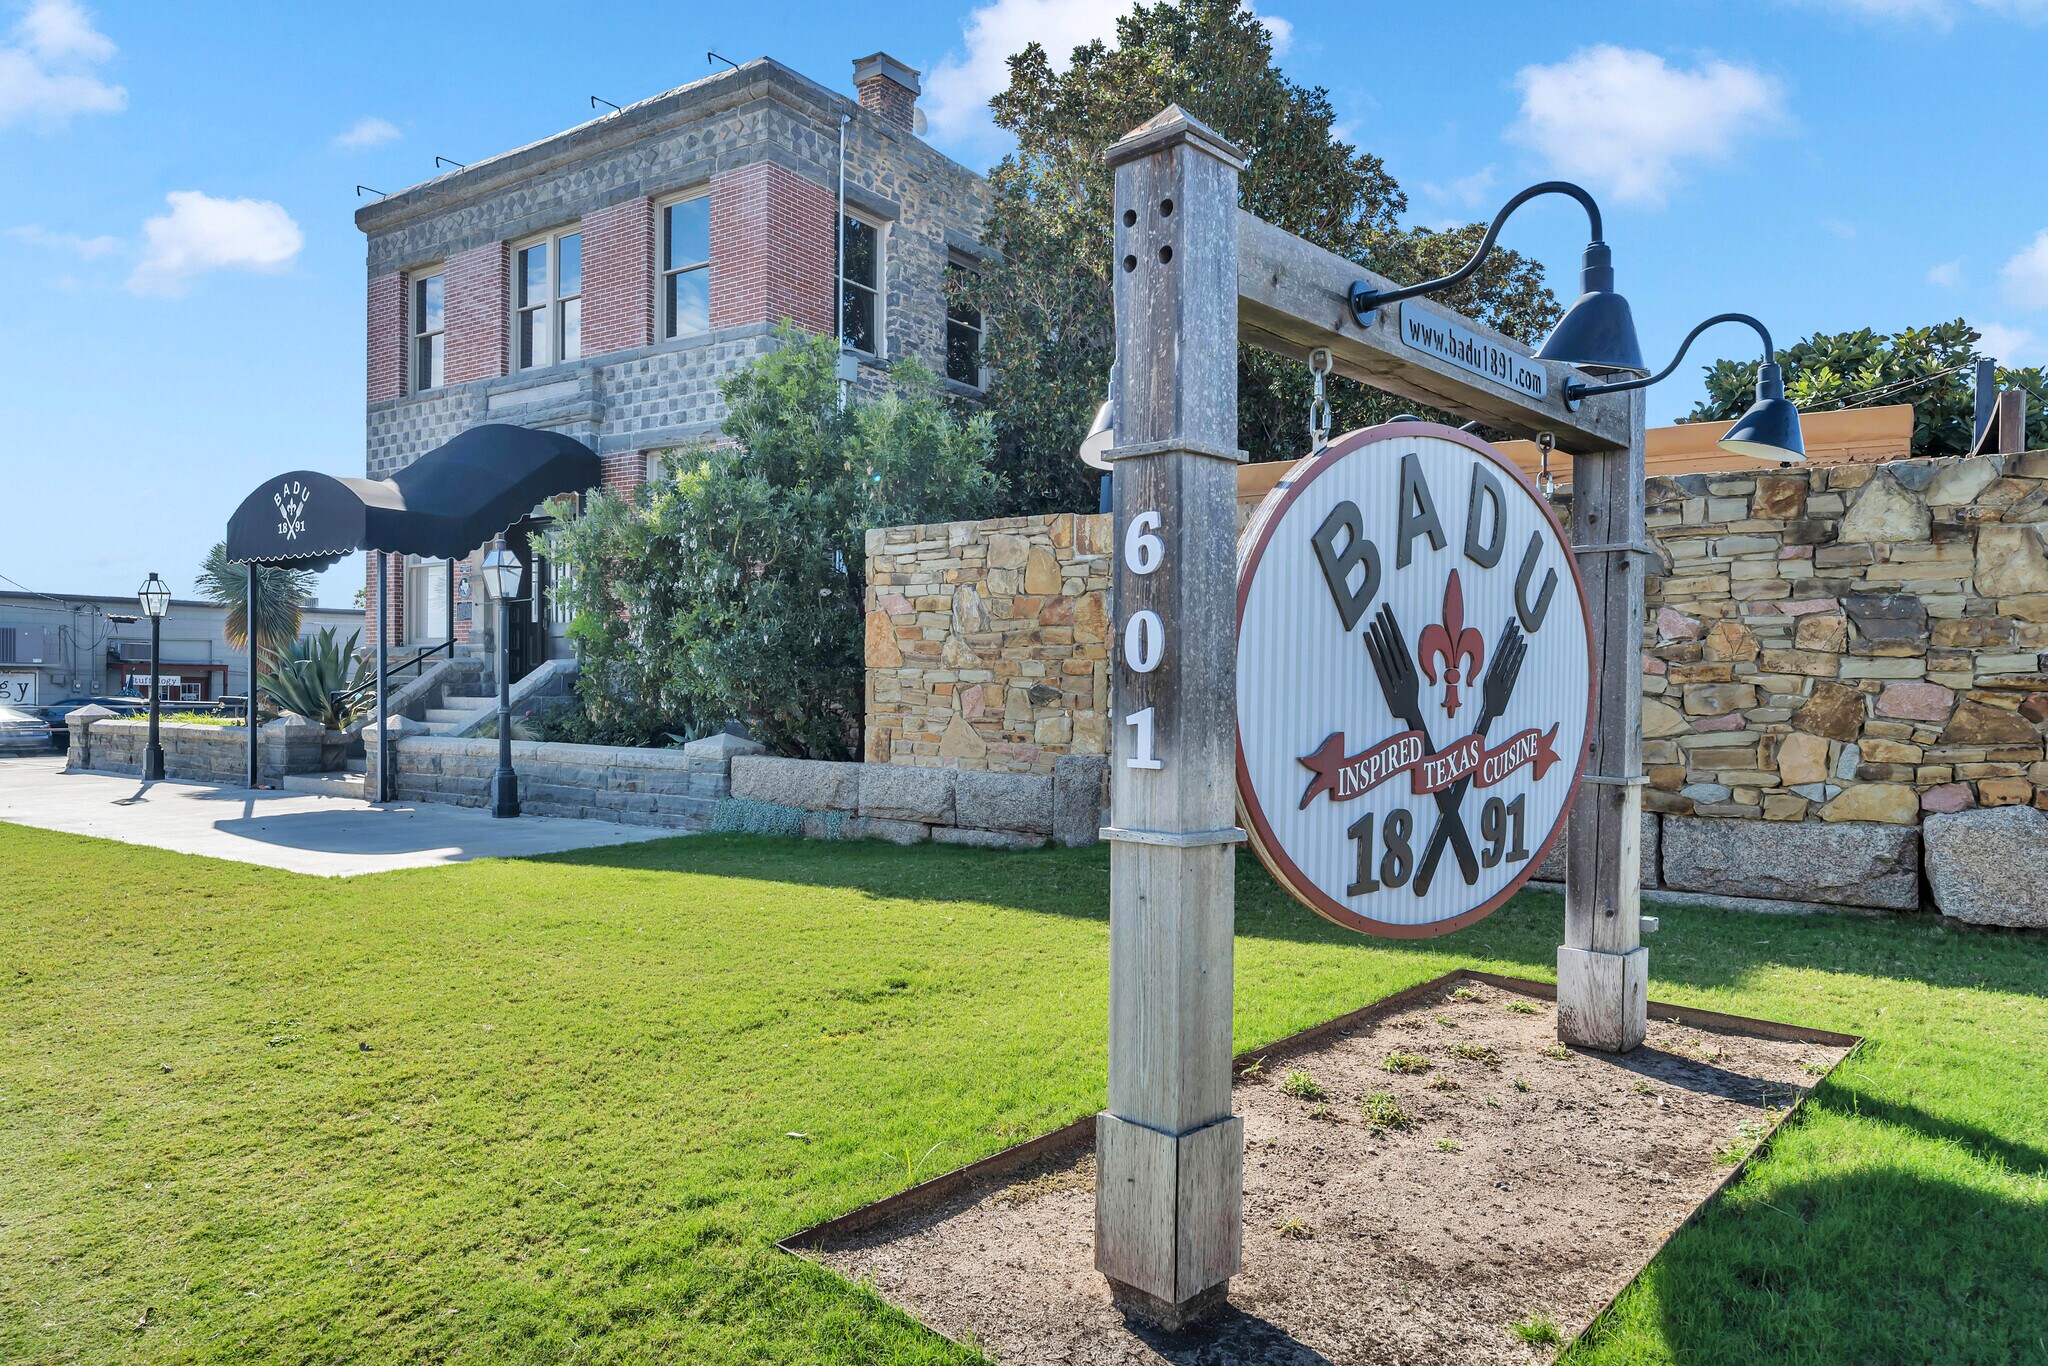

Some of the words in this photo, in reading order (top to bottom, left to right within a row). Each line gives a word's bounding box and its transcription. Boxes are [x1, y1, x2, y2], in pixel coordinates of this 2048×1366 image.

[1408, 318, 1542, 395] www.badu1891.com
[273, 480, 310, 507] BADU
[1311, 452, 1559, 633] BADU
[1124, 511, 1165, 770] 601
[1337, 736, 1423, 796] INSPIRED
[1423, 740, 1479, 789] TEXAS
[1483, 733, 1538, 783] CUISINE
